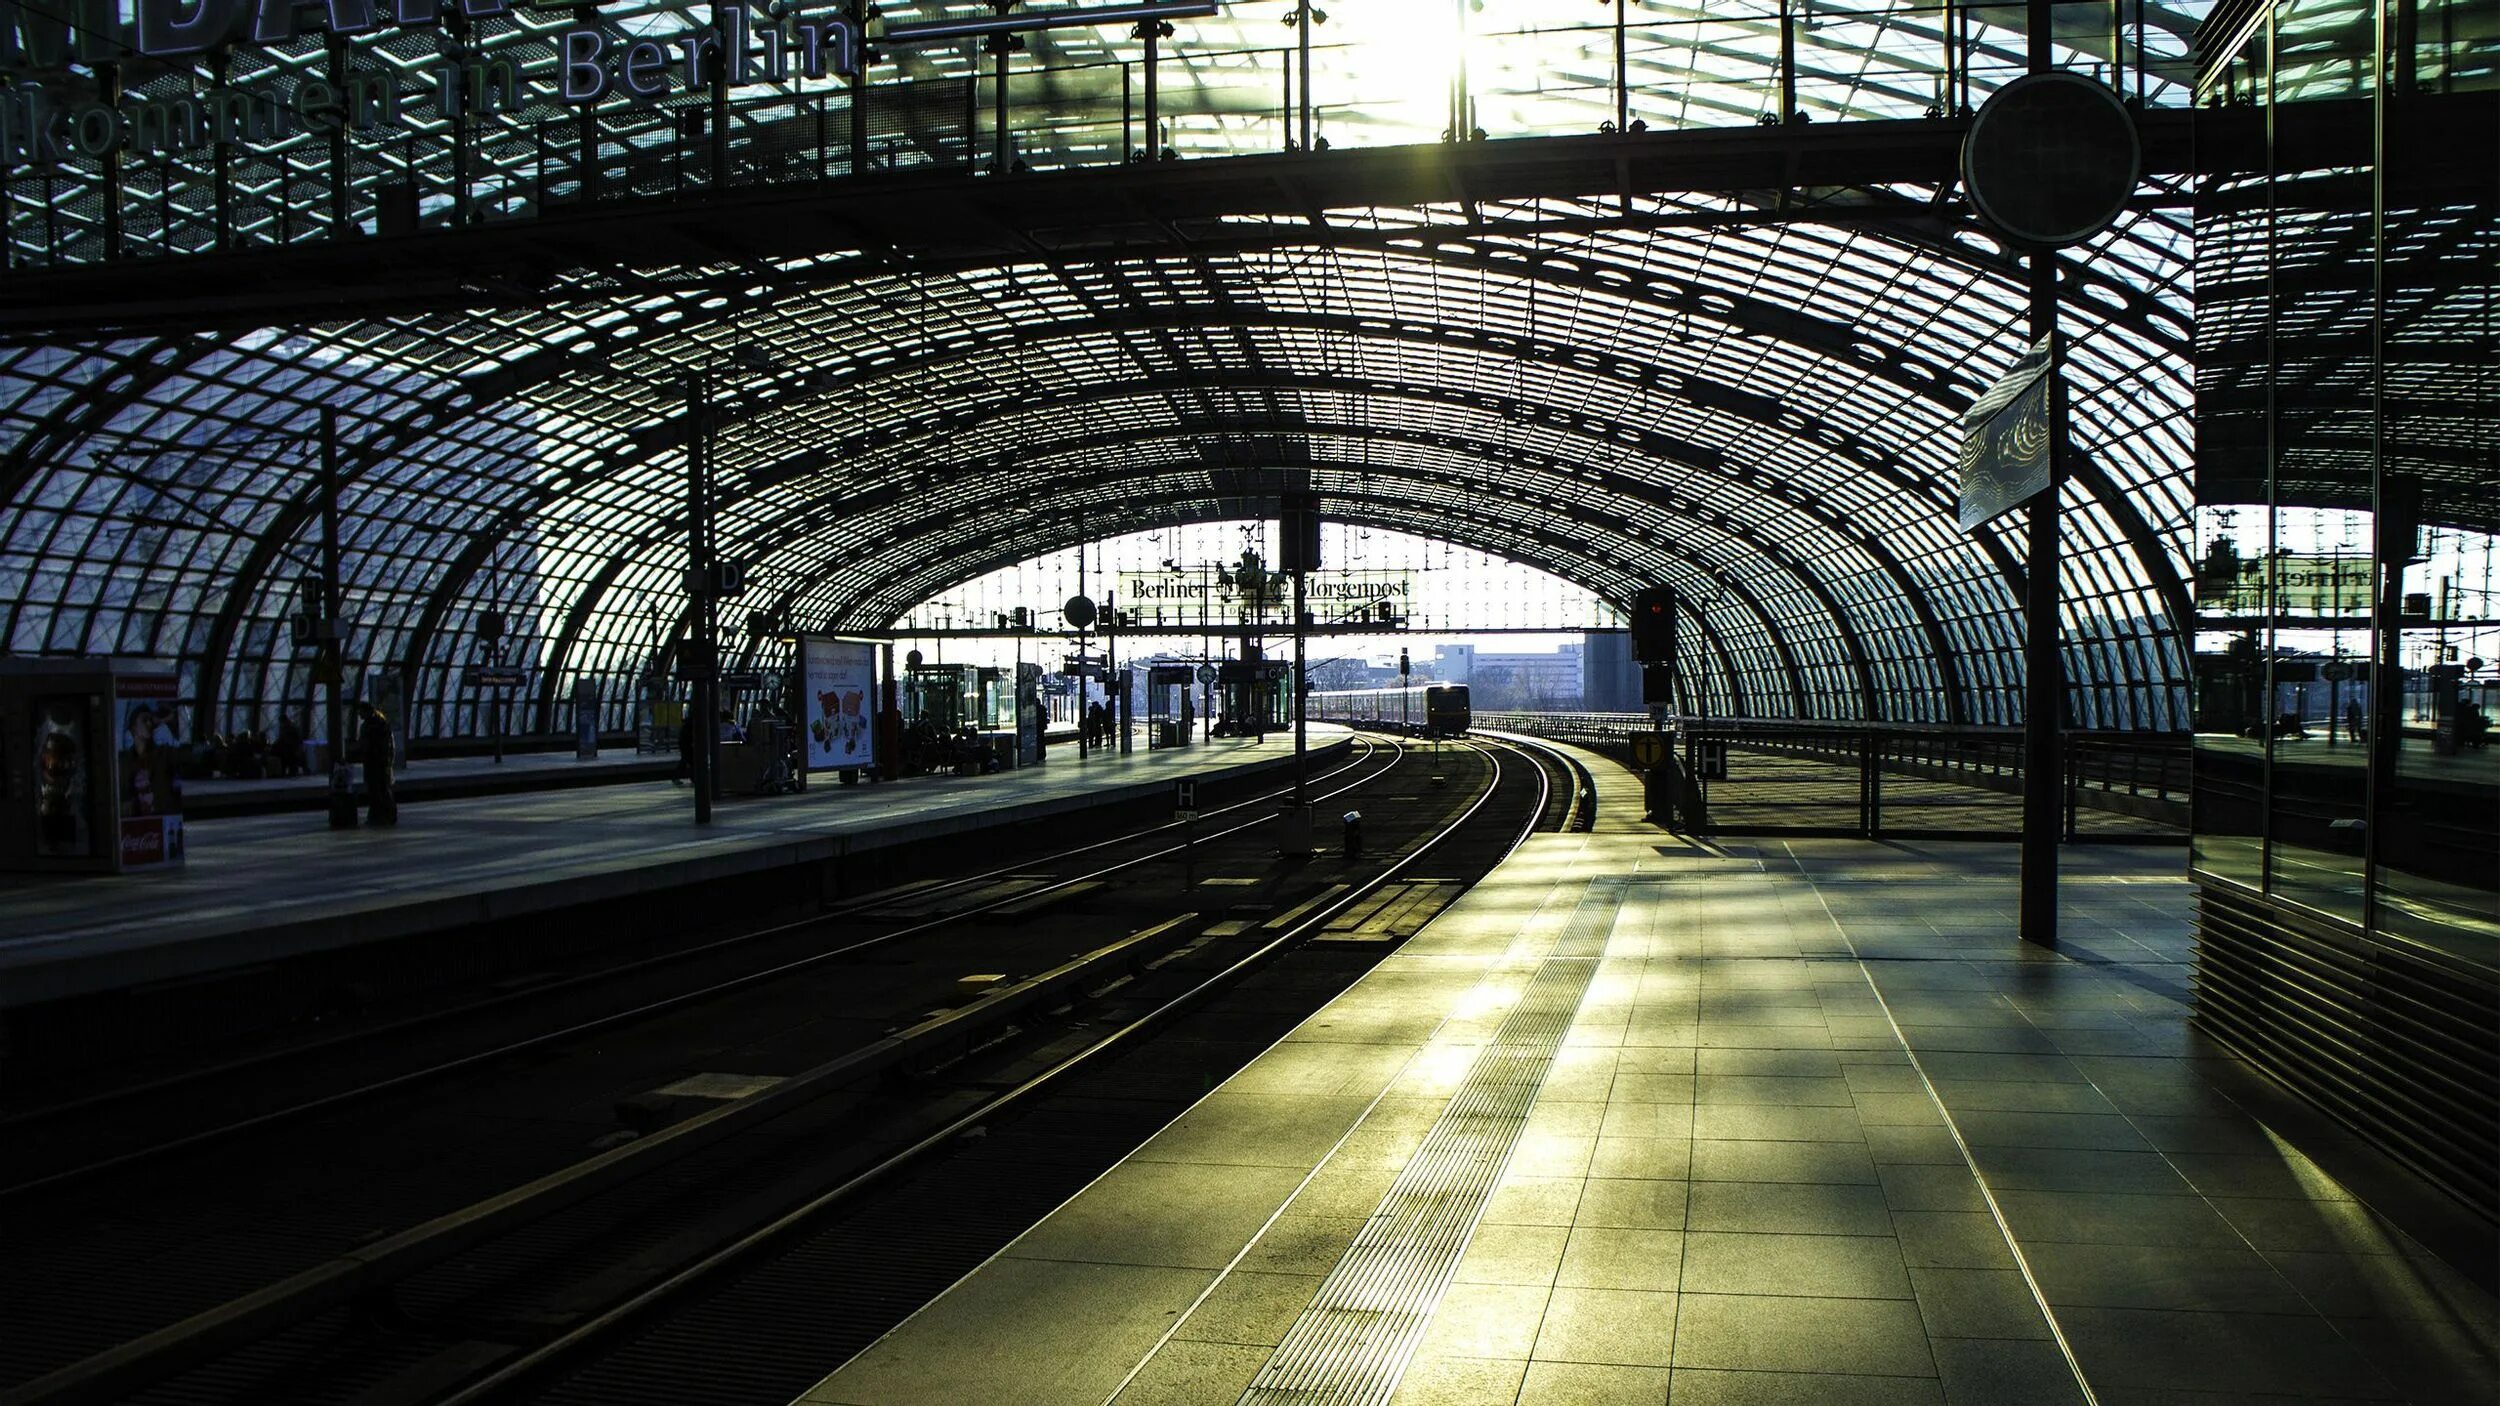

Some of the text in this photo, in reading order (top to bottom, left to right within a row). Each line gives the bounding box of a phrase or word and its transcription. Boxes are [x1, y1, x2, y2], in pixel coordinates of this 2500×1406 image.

[432, 40, 520, 116] in
[560, 1, 857, 104] Berlin
[722, 564, 739, 590] D
[1132, 578, 1206, 599] Berliner
[1701, 744, 1721, 774] H
[1178, 782, 1194, 807] H
